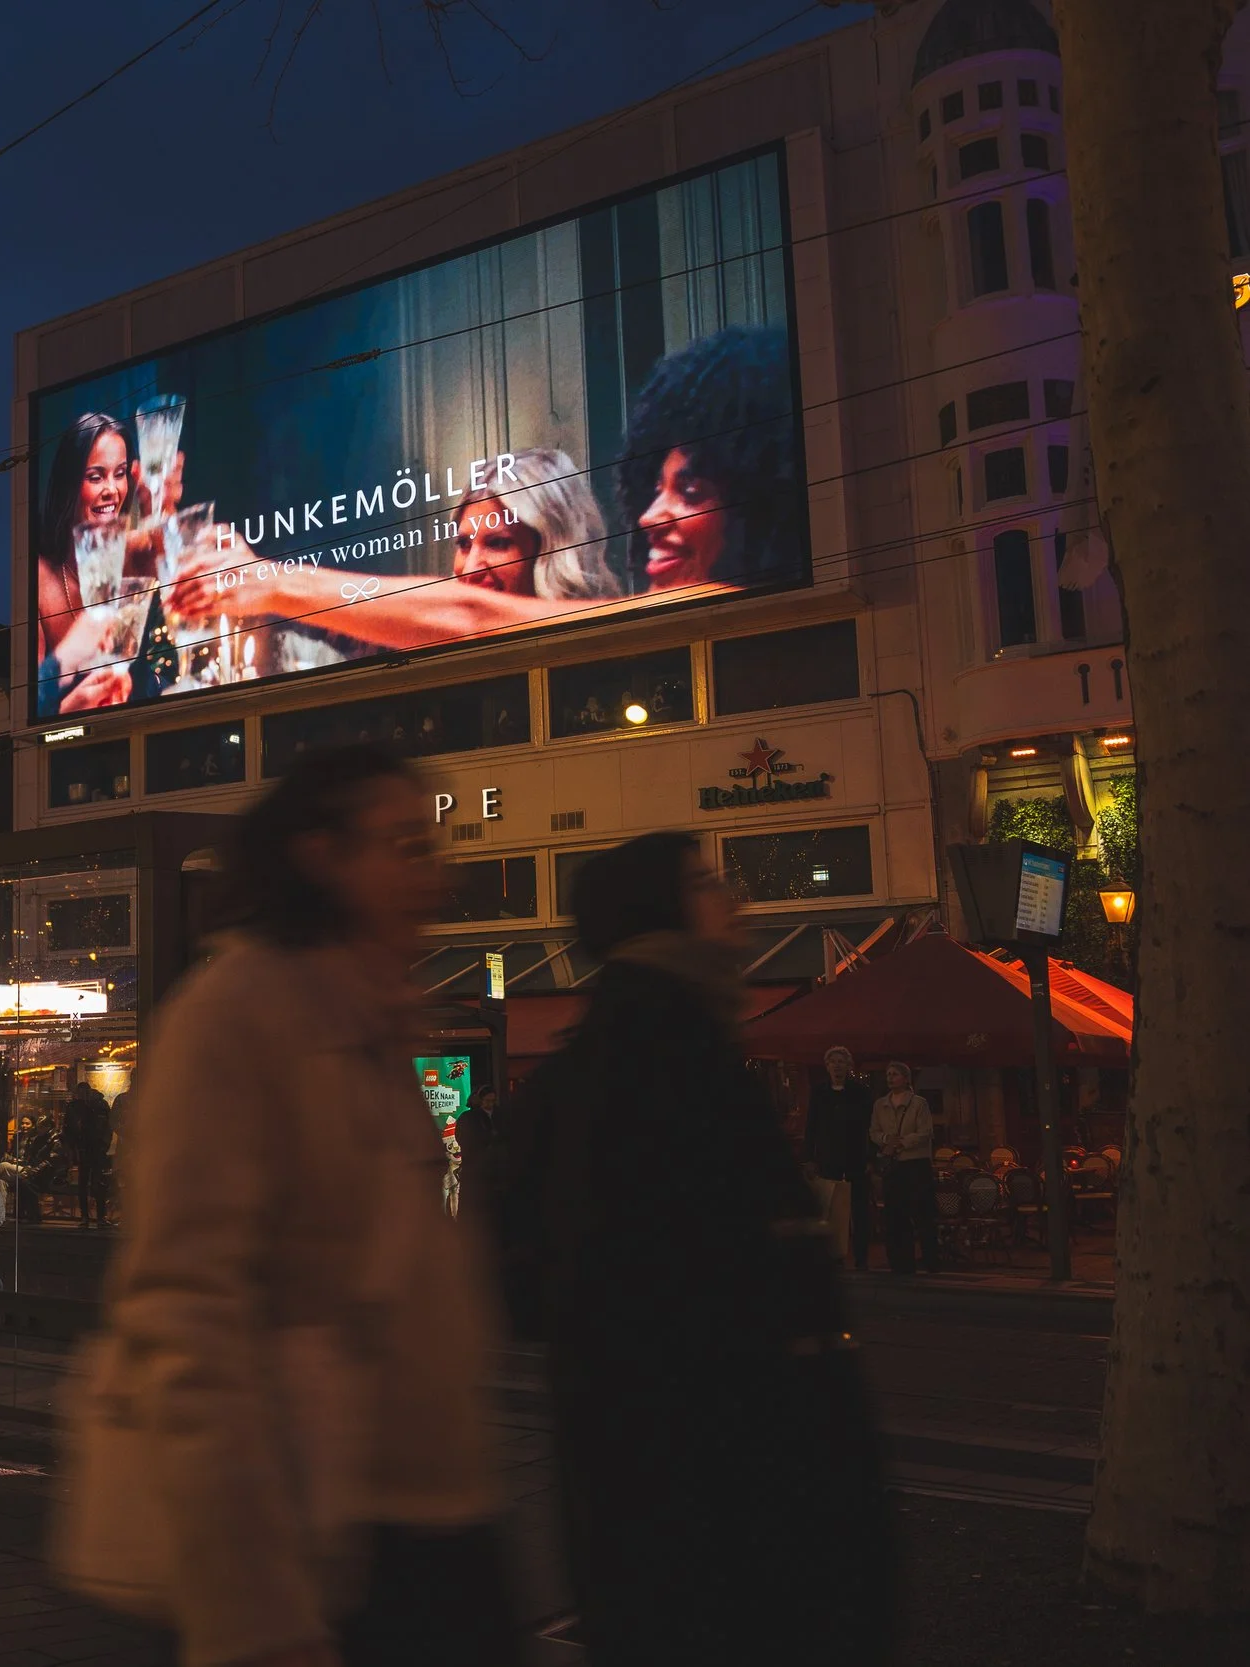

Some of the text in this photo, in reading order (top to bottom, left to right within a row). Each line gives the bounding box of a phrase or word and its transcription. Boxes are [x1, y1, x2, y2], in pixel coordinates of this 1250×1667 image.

[216, 453, 519, 553] HUNKEMÖLLER
[215, 507, 520, 592] for every woman in you
[699, 778, 827, 809] Heineken
